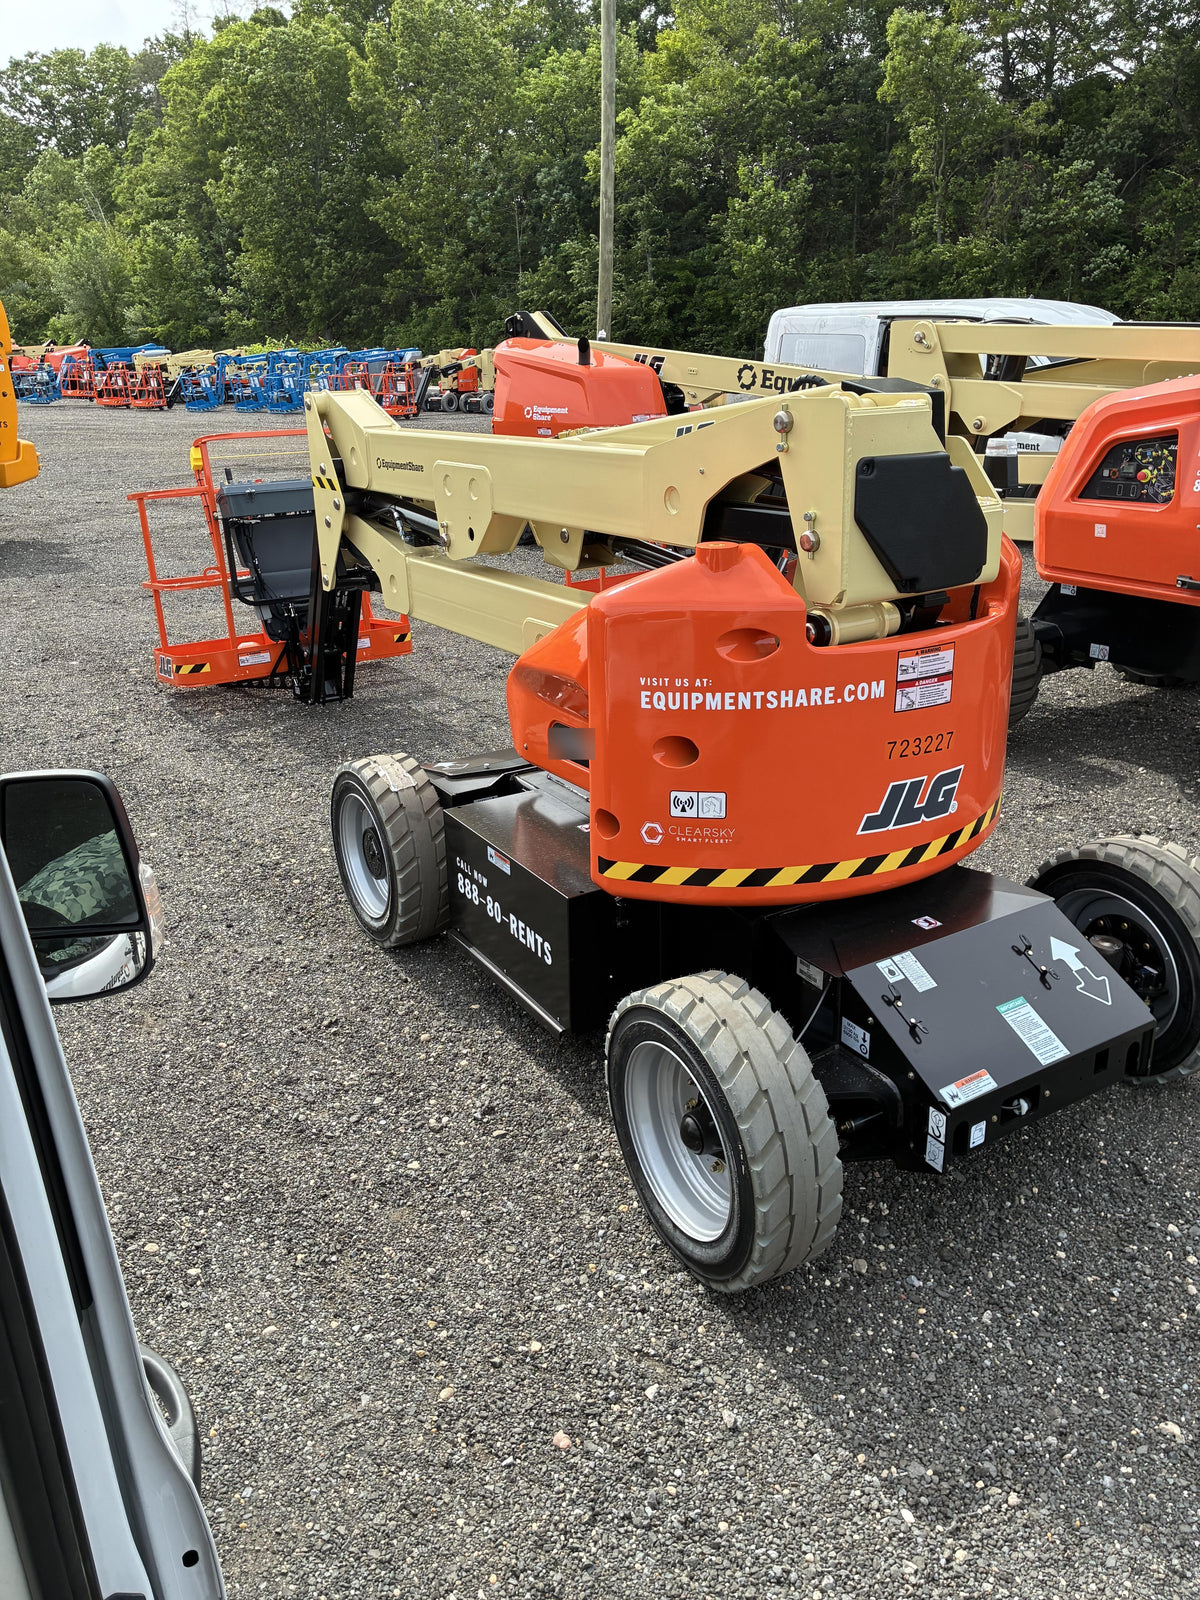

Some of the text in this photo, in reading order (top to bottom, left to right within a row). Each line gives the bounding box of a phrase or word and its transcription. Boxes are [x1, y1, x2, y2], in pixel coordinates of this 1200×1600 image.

[532, 413, 552, 421] Share
[533, 405, 568, 415] Equipment
[1017, 442, 1041, 452] ment
[381, 458, 424, 473] EquipmentShare
[639, 677, 713, 688] VISIT US AT:
[640, 679, 886, 711] EQUIPMENTSHARE.COM
[887, 731, 954, 760] 723227
[856, 764, 964, 835] JLG
[668, 825, 736, 838] CLEARSKY
[456, 856, 472, 876] CALL
[473, 869, 488, 888] NOW
[457, 872, 552, 966] 888-80-RENTS
